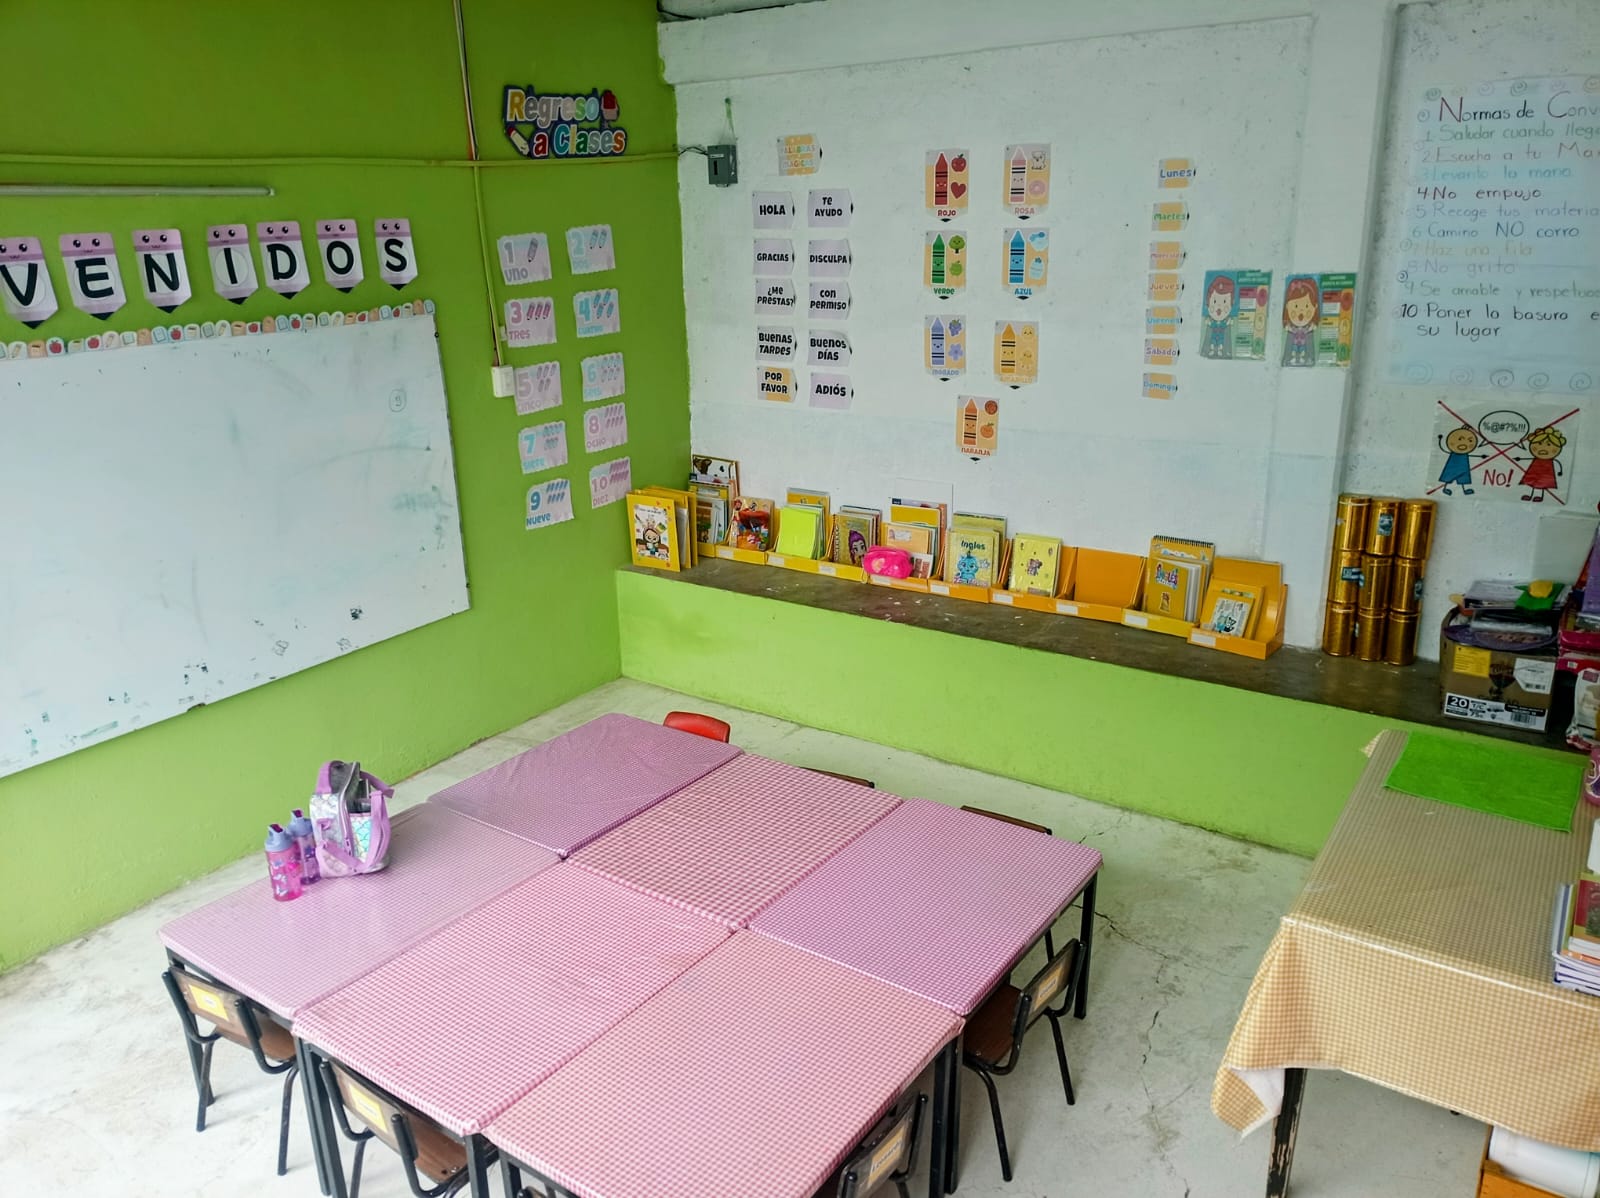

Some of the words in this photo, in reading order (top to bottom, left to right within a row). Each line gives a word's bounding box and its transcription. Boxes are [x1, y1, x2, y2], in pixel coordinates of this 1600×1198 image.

[507, 89, 600, 128] Regreso
[1439, 96, 1511, 123] Normas
[1516, 99, 1535, 120] de
[533, 132, 549, 156] a
[554, 123, 625, 155] Clases
[1439, 124, 1496, 142] Saludar
[1502, 120, 1554, 138] cuando
[1435, 146, 1491, 163] Escucha
[1503, 151, 1513, 161] a
[1526, 143, 1541, 160] tu
[1160, 169, 1192, 178] Lunes
[1504, 164, 1518, 179] la
[1433, 185, 1457, 200] No
[1475, 188, 1542, 201] empujo
[759, 204, 787, 216] HOLA
[814, 208, 843, 217] AYUDO
[937, 209, 957, 217] ROJO
[1015, 207, 1035, 215] ROSA
[1433, 201, 1488, 222] Recoge
[1498, 204, 1521, 217] tus
[1428, 223, 1479, 238] Camino
[1495, 221, 1525, 238] NO
[1536, 227, 1580, 239] corro
[571, 230, 585, 257] 2
[504, 241, 515, 265] 1
[756, 252, 789, 262] GRACIAS
[809, 254, 848, 264] DISCULPA
[1424, 258, 1449, 273] No
[1467, 256, 1516, 278] grito
[1420, 279, 1440, 296] Se
[1452, 283, 1500, 296] amable
[510, 301, 522, 324] 3
[578, 297, 591, 322] 4
[1427, 302, 1472, 319] Poner
[1485, 303, 1500, 319] la
[1513, 306, 1568, 320] basura
[1417, 324, 1440, 337] su
[1455, 321, 1500, 342] lugar
[817, 348, 839, 361] DÍAS
[765, 371, 782, 381] POR
[761, 383, 788, 394] FAVOR
[815, 384, 846, 397] ADIÓS
[589, 416, 599, 434] 8
[524, 434, 536, 454] 7
[591, 477, 608, 493] 10
[1483, 469, 1514, 487] No!
[530, 491, 541, 511] 9
[1451, 696, 1467, 709] 20
